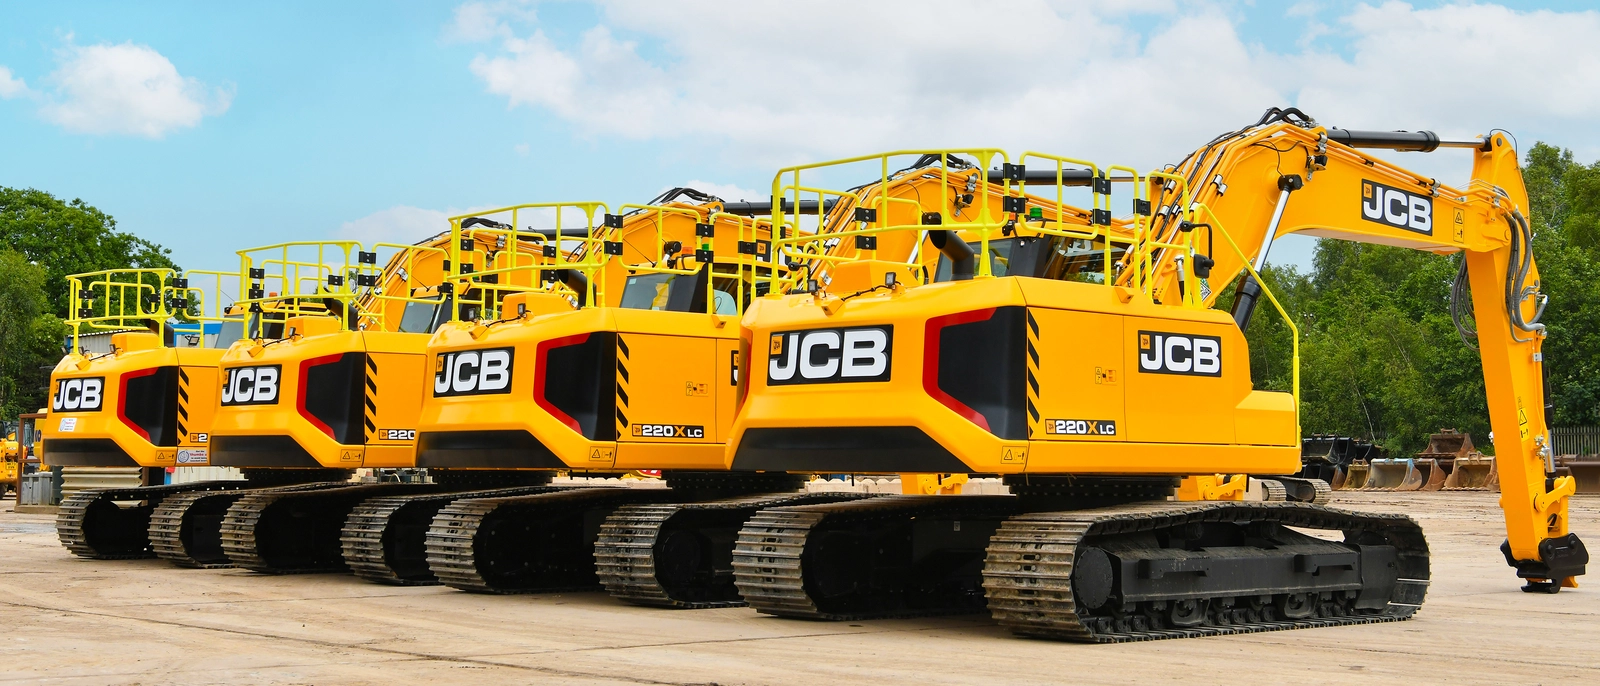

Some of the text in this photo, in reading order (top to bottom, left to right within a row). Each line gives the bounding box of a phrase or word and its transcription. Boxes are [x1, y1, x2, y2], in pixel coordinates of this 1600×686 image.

[1363, 186, 1432, 232] JCB
[434, 350, 510, 394] JCB
[769, 329, 887, 381] JCB
[1140, 335, 1221, 374] JCB
[53, 378, 102, 410] JCB
[221, 366, 278, 403] JCB
